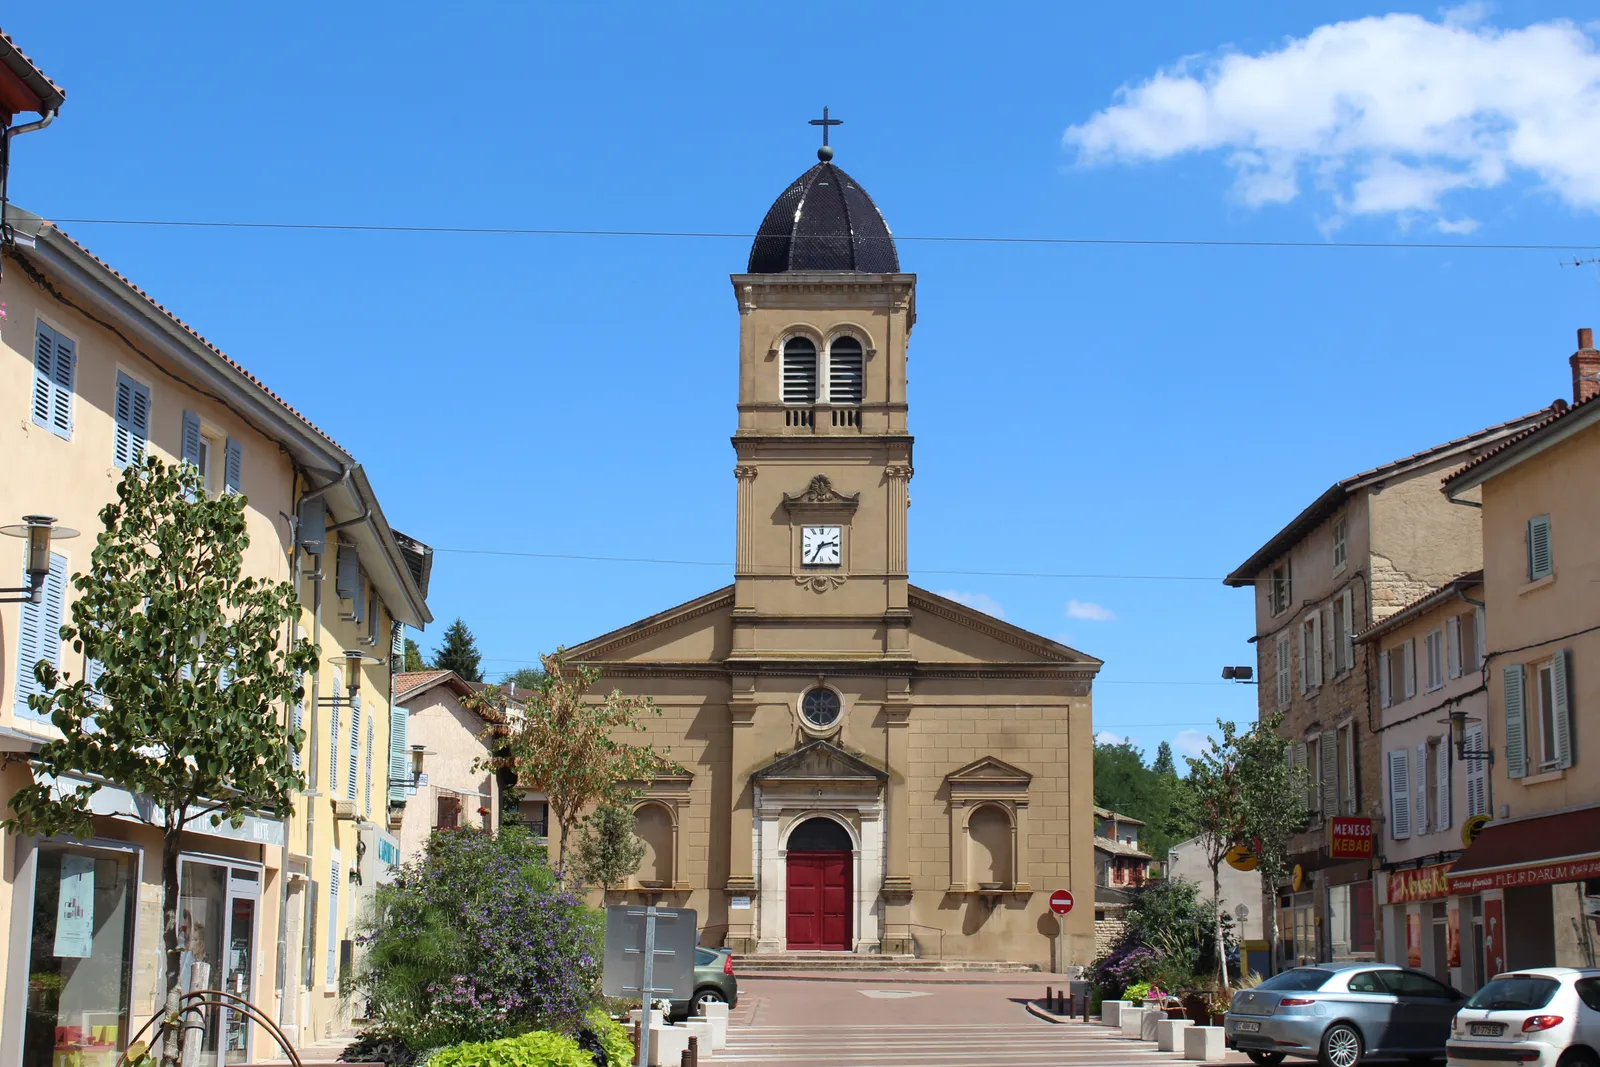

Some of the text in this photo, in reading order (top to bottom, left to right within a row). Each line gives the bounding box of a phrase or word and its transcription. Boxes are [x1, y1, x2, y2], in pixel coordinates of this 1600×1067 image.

[1333, 823, 1371, 836] MENESS
[1333, 838, 1370, 852] KEBAB
[1495, 871, 1525, 886] FLEUR
